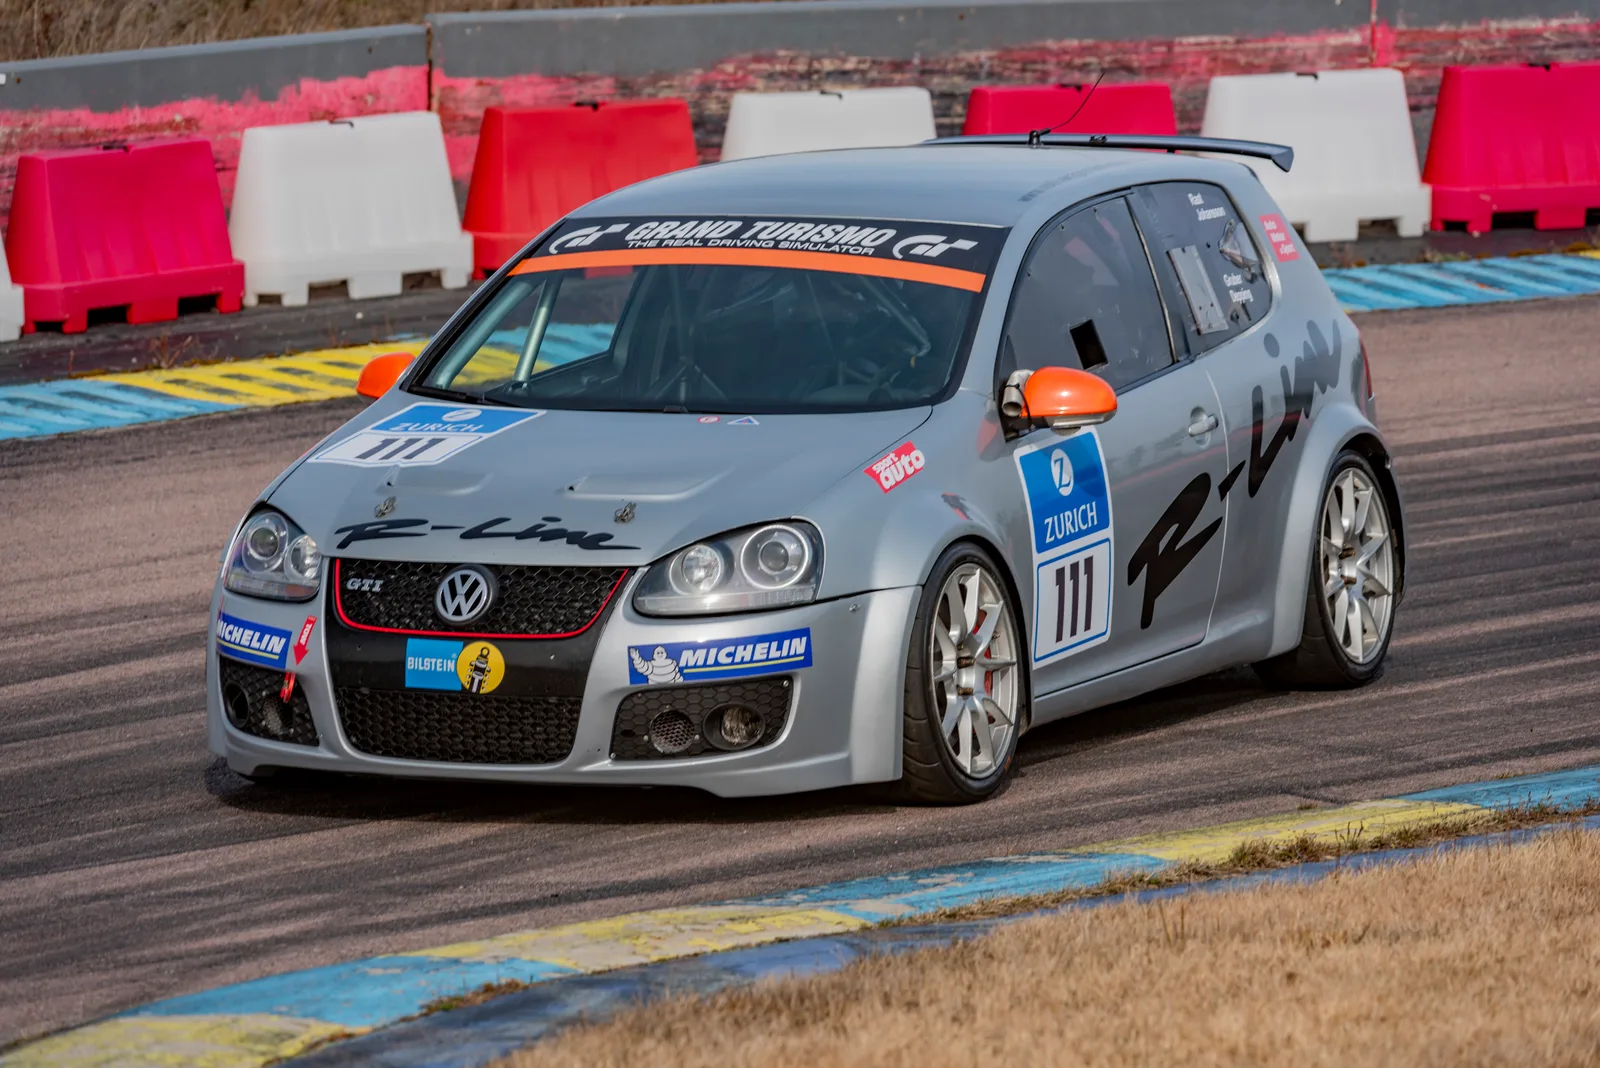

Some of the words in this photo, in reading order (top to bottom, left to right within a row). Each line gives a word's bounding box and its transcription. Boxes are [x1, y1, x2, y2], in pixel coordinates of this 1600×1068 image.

[624, 220, 741, 242] GRAND
[740, 221, 897, 247] TURISMO
[628, 239, 653, 249] THE
[656, 238, 703, 248] REAL
[708, 238, 774, 250] DRIVING
[779, 240, 875, 256] SIMULATOR
[389, 422, 484, 433] ZURICH
[355, 437, 448, 460] 111
[880, 450, 925, 489] auto
[334, 516, 642, 550] R-Line
[1044, 501, 1098, 543] ZURICH
[346, 577, 384, 592] GTI
[1055, 555, 1094, 643] 111
[407, 656, 455, 673] BILSTEIN
[680, 636, 807, 667] MICHELIN
